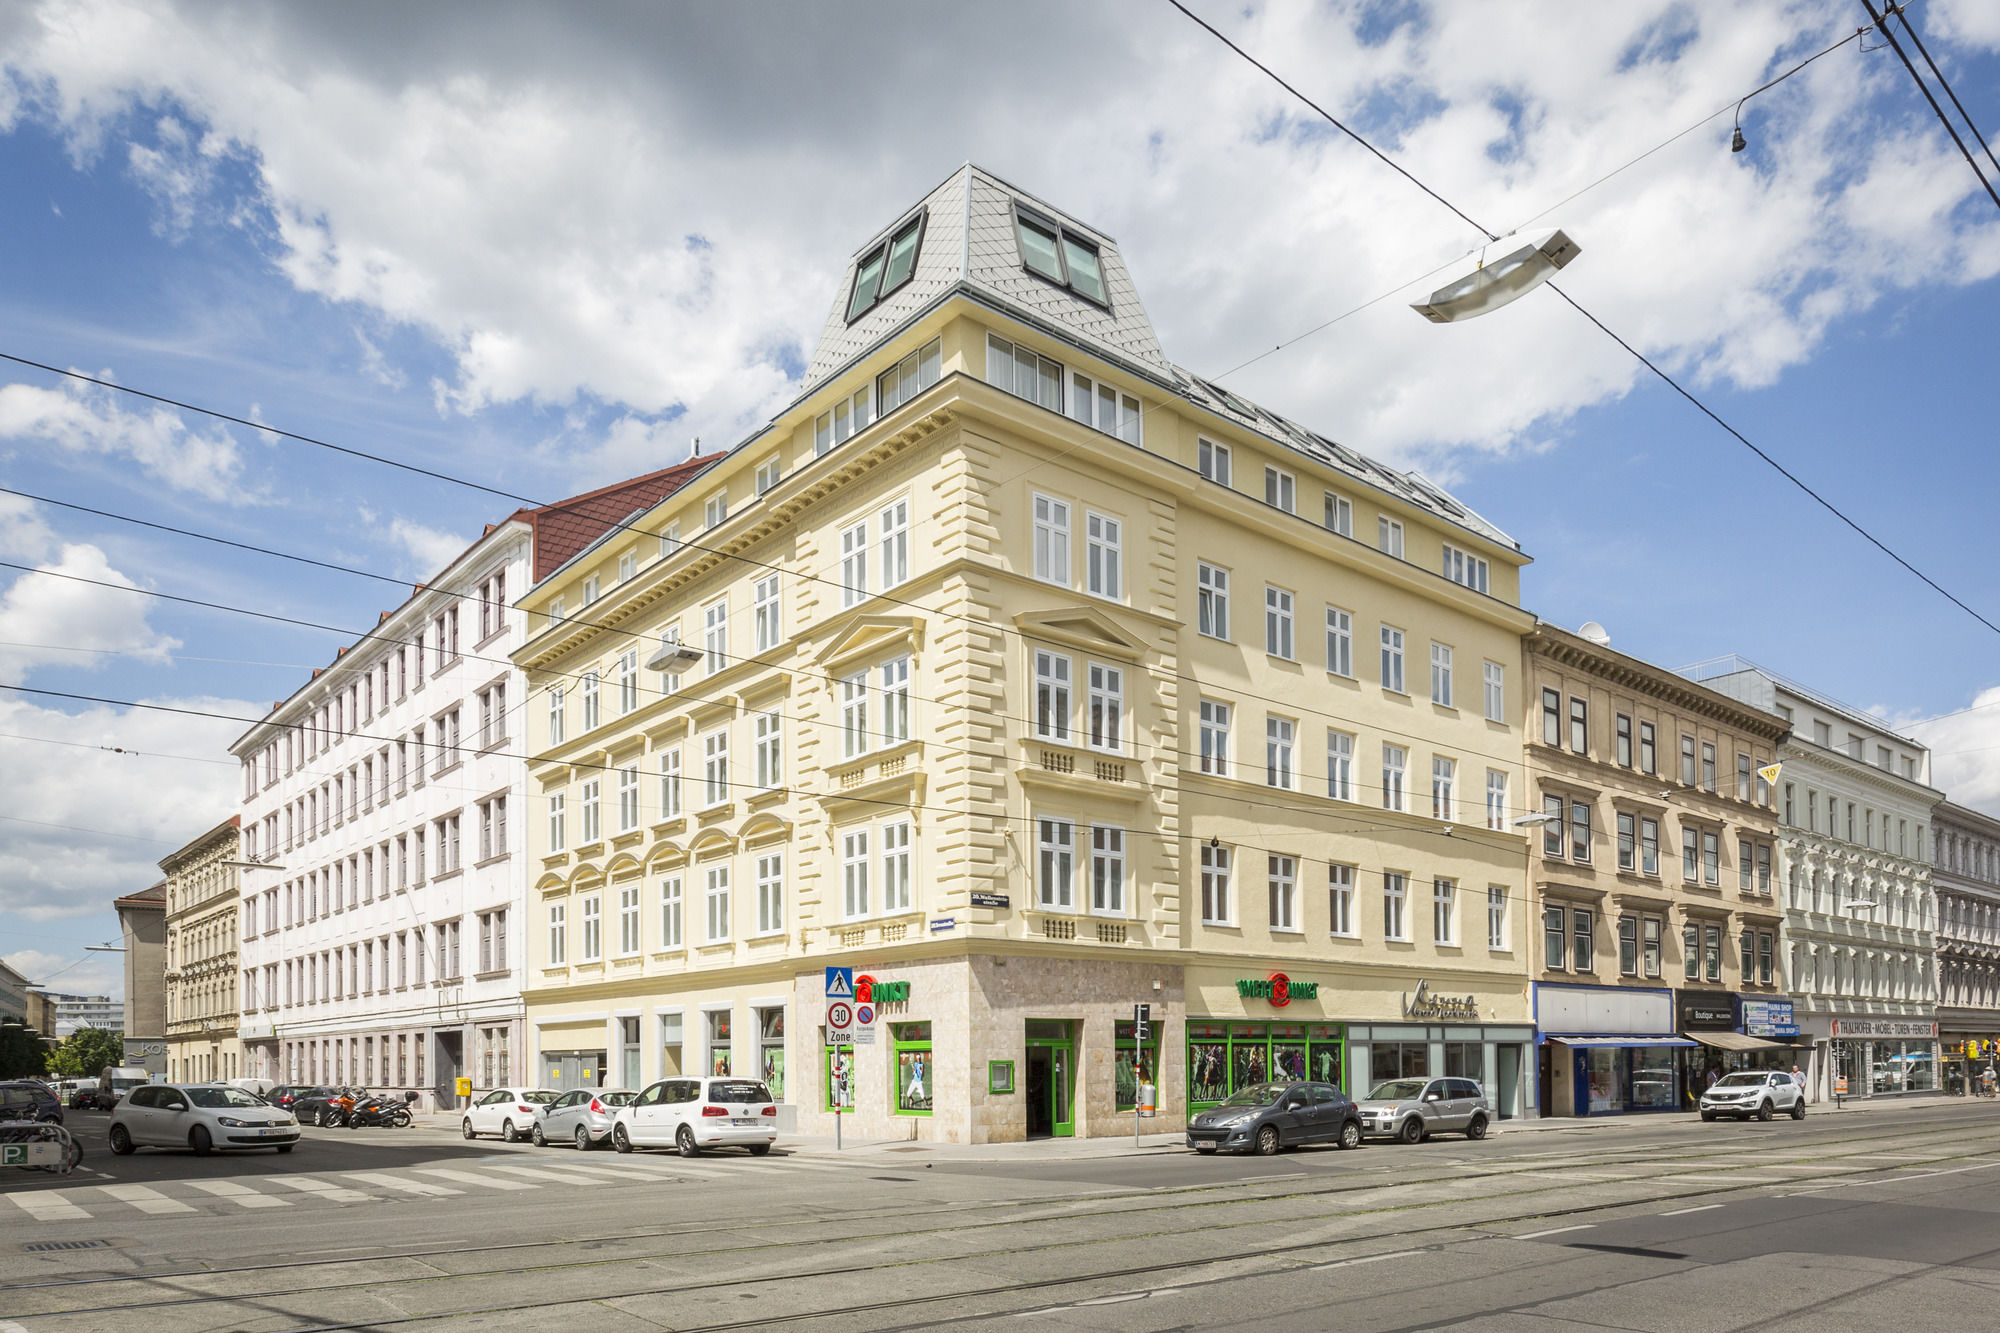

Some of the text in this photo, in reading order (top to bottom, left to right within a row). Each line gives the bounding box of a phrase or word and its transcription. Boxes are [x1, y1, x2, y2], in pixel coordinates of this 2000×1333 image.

[1766, 769, 1776, 777] 10
[835, 1009, 846, 1022] 30
[1695, 1010, 1713, 1021] Boutique
[1840, 1021, 1872, 1034] THALHOFER
[1912, 1024, 1931, 1034] FENSTER
[830, 1031, 851, 1042] Zone
[4, 1146, 22, 1164] P
